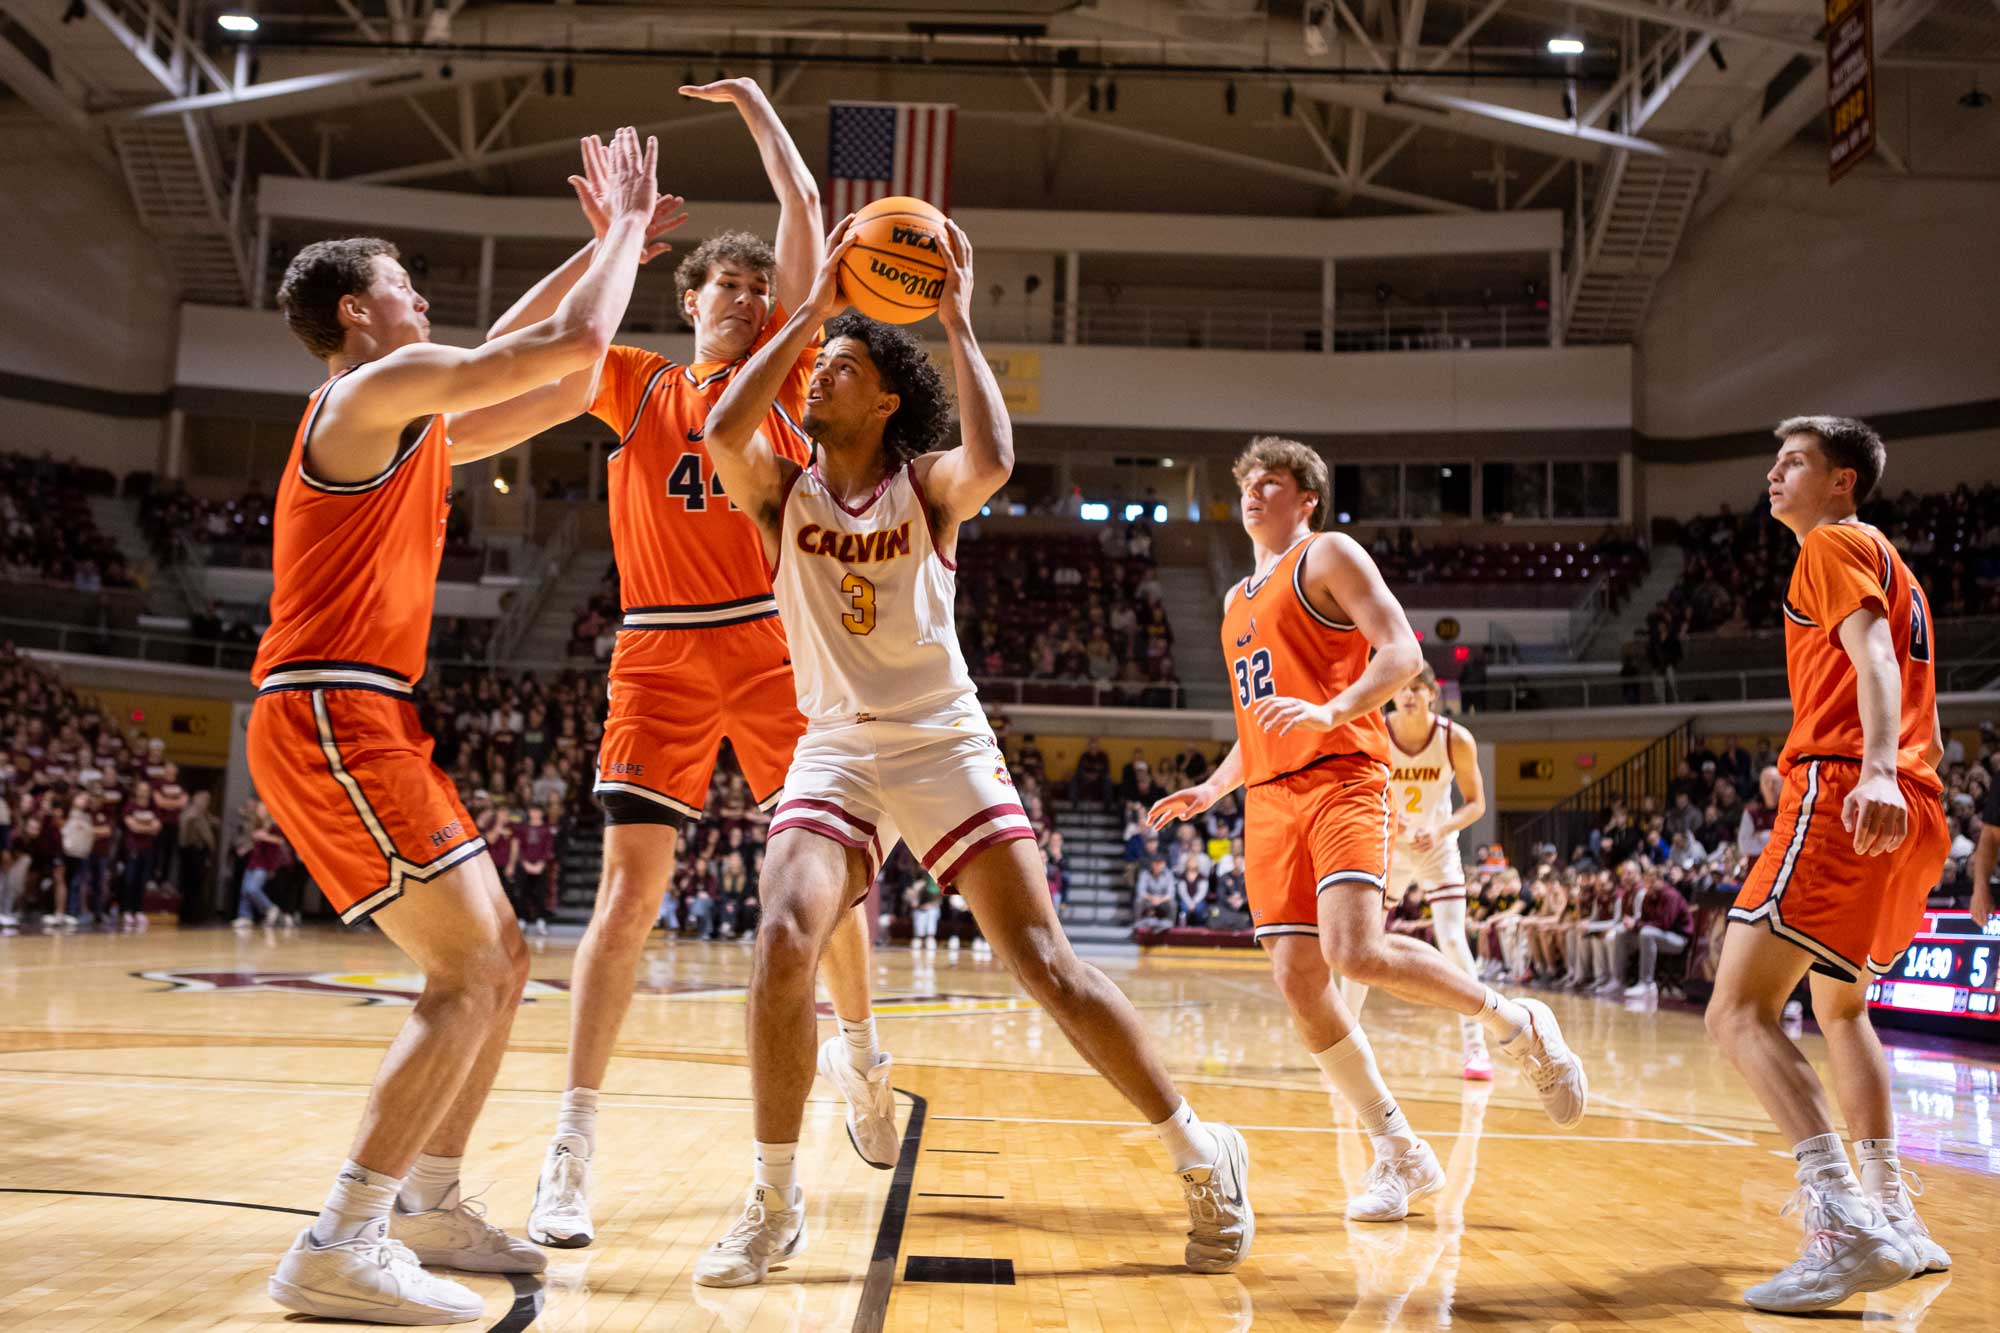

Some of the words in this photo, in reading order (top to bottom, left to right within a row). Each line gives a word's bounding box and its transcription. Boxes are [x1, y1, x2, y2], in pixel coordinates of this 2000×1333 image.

[870, 258, 945, 299] Wilson
[796, 521, 912, 564] CALVIN
[841, 573, 876, 635] 3
[1234, 647, 1276, 710] 32
[609, 762, 645, 777] HOPE
[1390, 767, 1441, 782] ALVIN
[1404, 786, 1422, 813] 2
[1904, 946, 1953, 979] 14:30
[1970, 947, 1990, 988] 5
